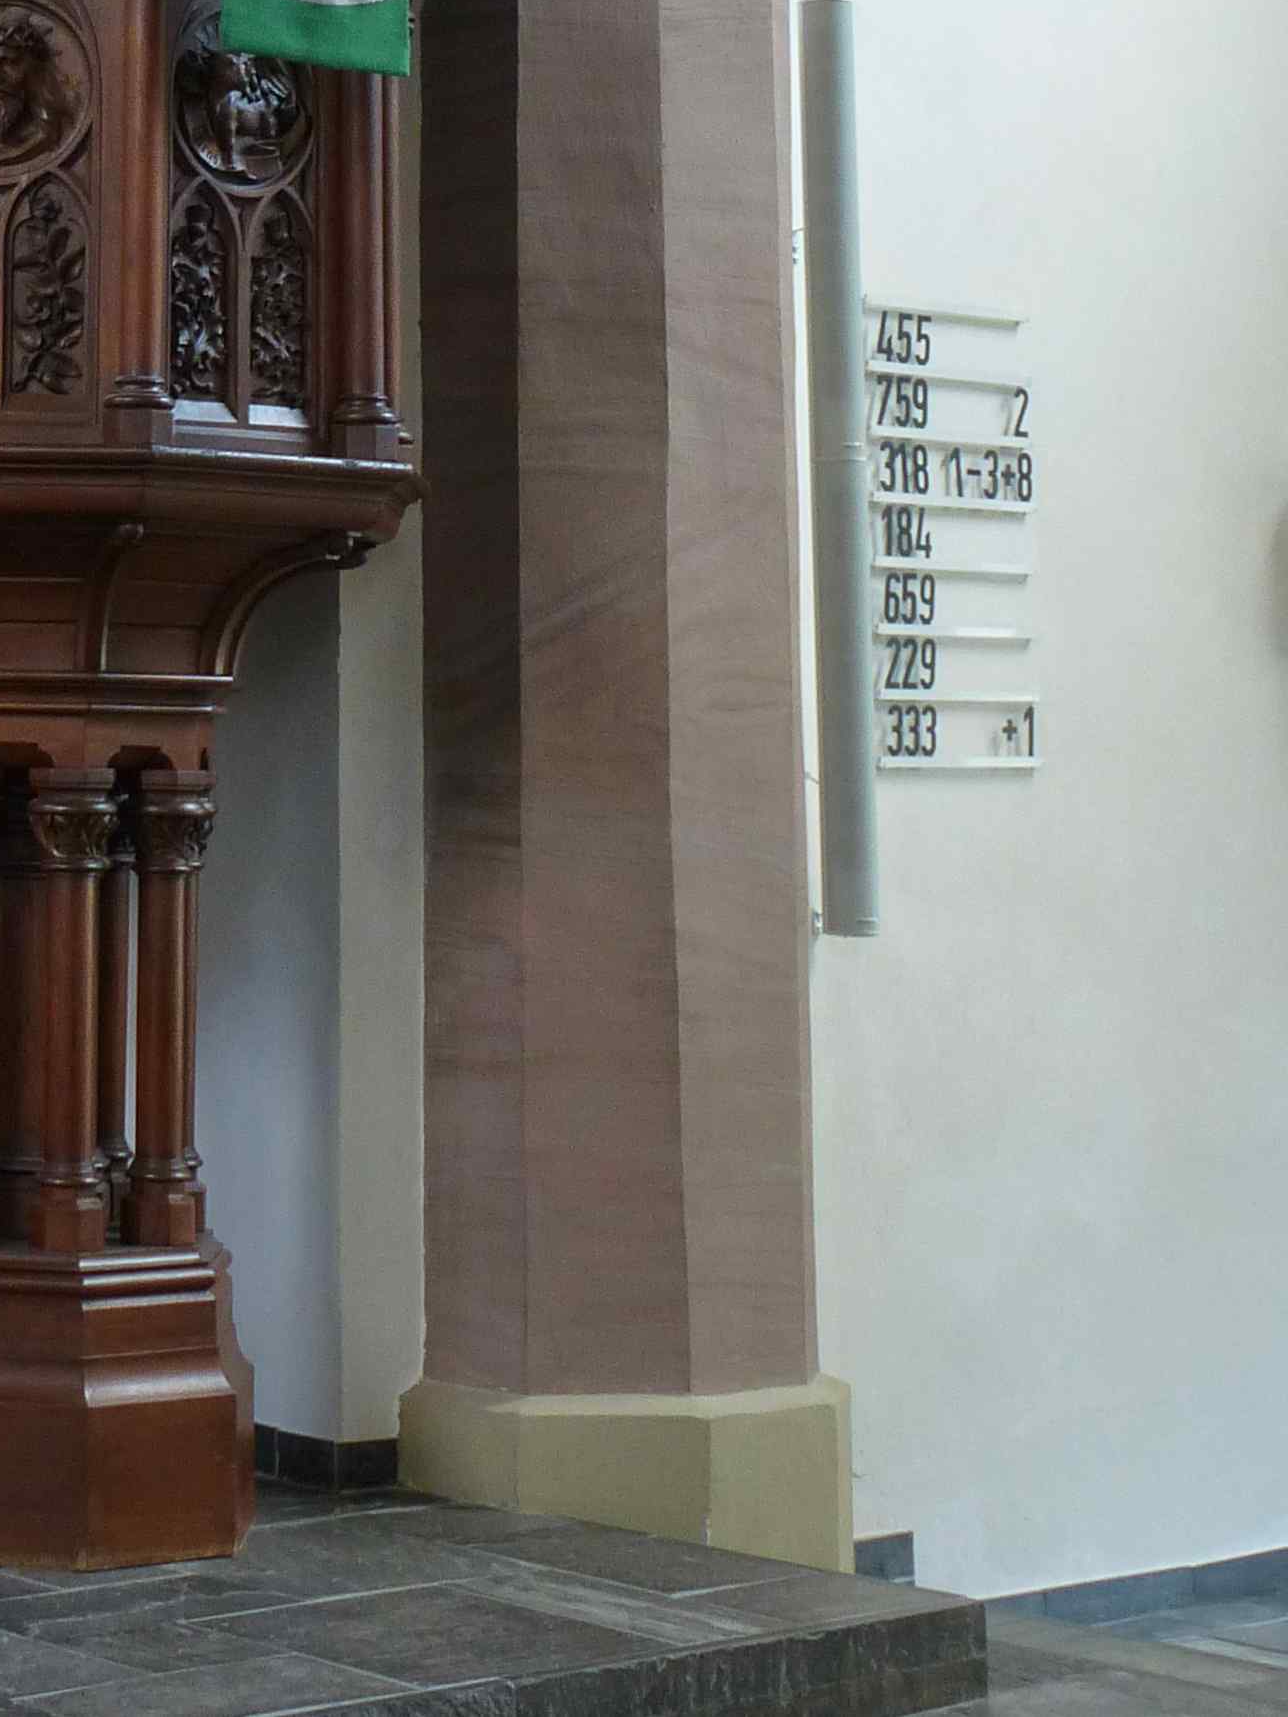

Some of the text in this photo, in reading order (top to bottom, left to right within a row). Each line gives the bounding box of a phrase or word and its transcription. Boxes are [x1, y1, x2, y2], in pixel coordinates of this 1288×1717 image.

[877, 310, 932, 366] 455
[876, 374, 1030, 438] 759 2
[880, 440, 929, 495] 318
[881, 505, 933, 559] 184
[884, 572, 937, 625] 659
[884, 638, 937, 690] 229
[887, 704, 938, 757] 333
